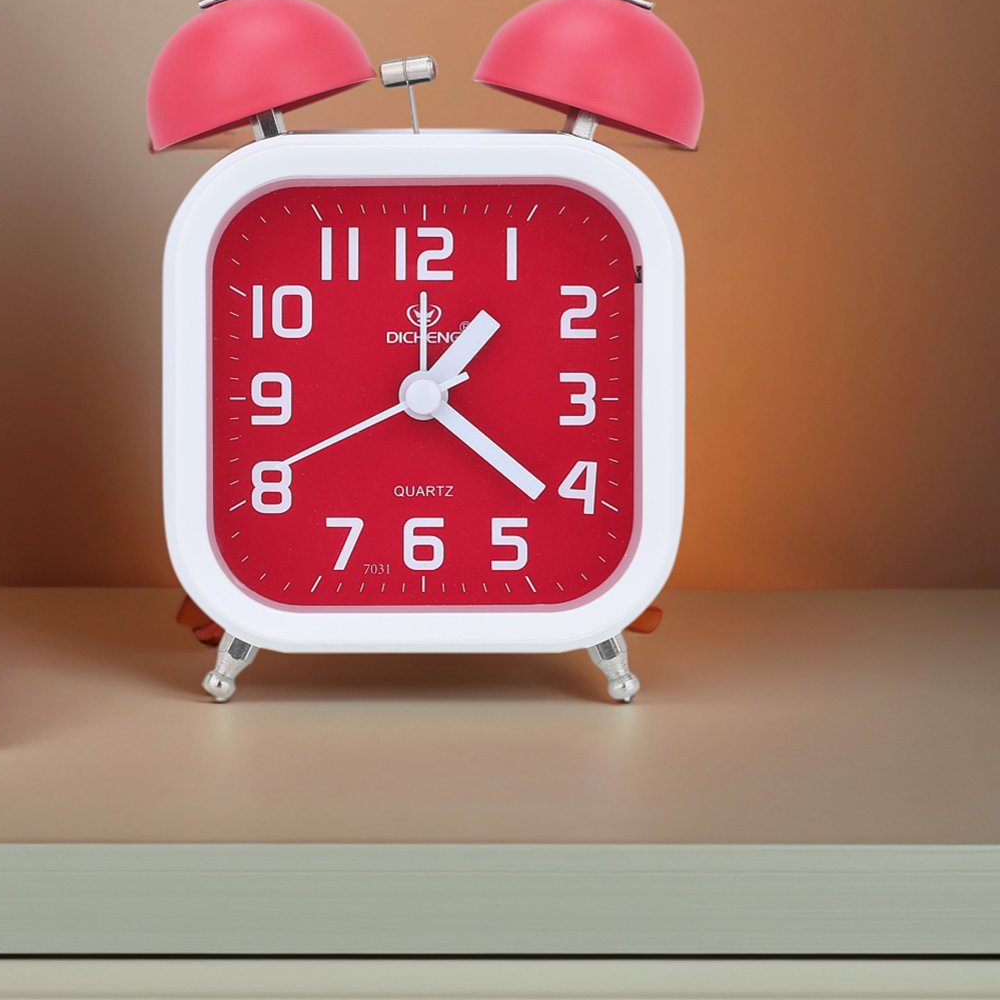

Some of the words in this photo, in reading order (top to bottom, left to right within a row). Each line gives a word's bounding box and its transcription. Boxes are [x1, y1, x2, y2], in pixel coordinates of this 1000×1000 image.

[321, 227, 359, 281] 11
[395, 227, 454, 281] 12
[506, 227, 518, 281] 1
[252, 285, 313, 339] 10
[559, 285, 598, 339] 2
[250, 372, 293, 426] 9
[558, 372, 597, 427] 3
[251, 461, 293, 514] 8
[393, 485, 454, 497] QUARTZ
[557, 460, 598, 515] 4
[325, 517, 365, 571] 7
[363, 564, 391, 575] 7031
[403, 517, 445, 571] 6
[490, 517, 529, 571] 5
